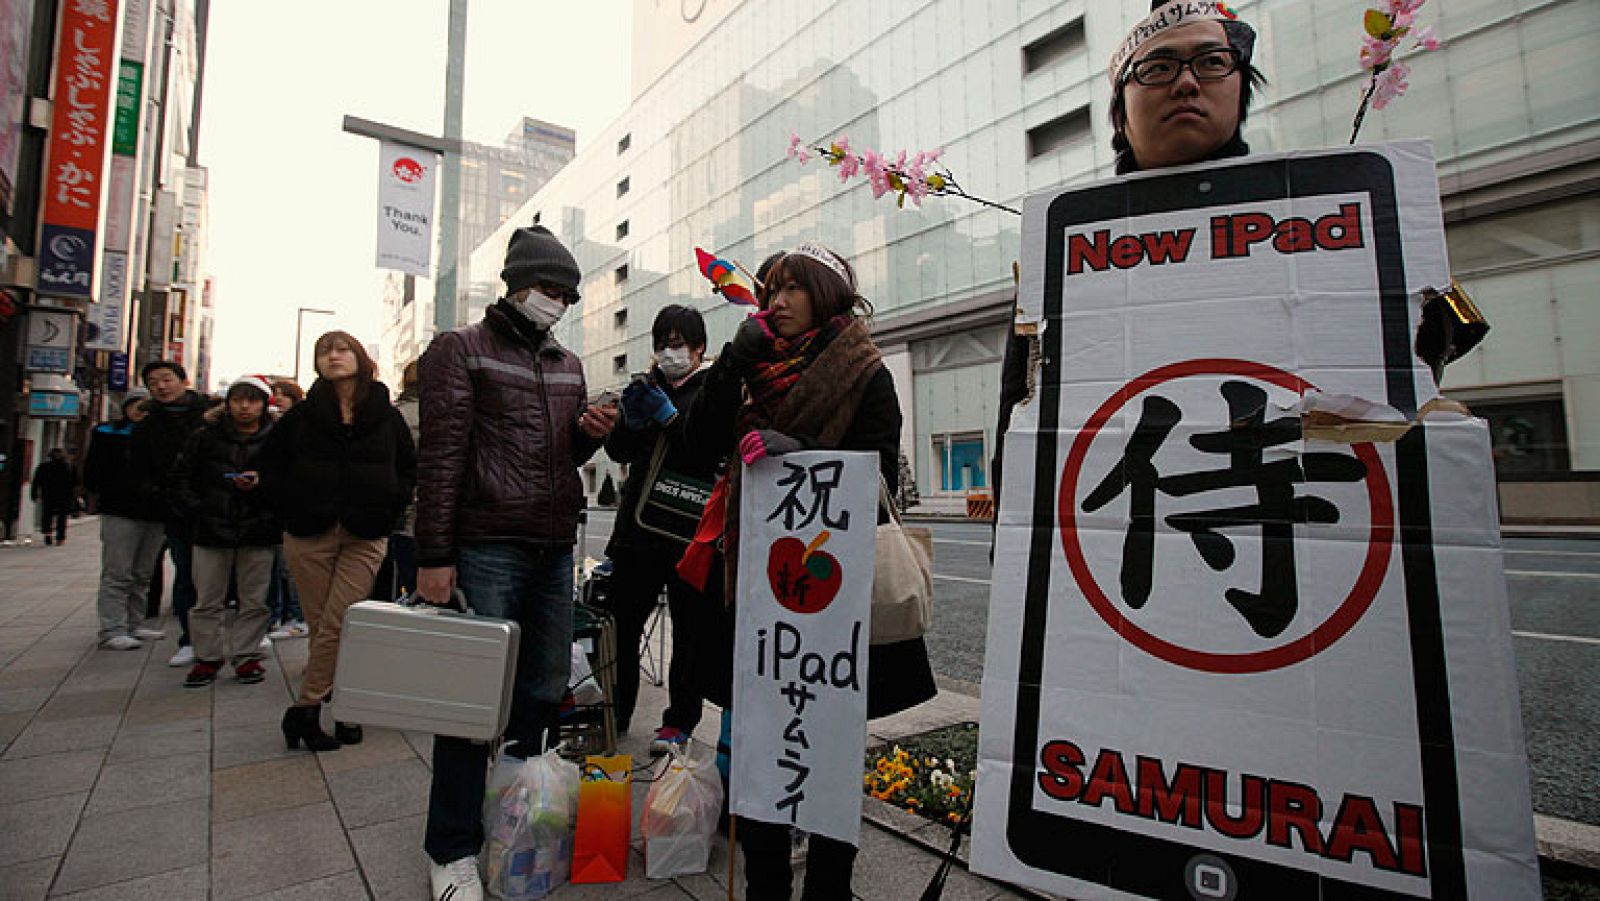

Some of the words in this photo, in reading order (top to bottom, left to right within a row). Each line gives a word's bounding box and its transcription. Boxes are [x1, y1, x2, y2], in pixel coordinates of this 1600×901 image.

[383, 206, 428, 225] Thank
[391, 219, 422, 236] You.
[1067, 228, 1196, 275] New
[1210, 202, 1365, 260] iPad
[766, 460, 850, 530] 祝
[1081, 380, 1368, 638] 侍
[757, 621, 862, 691] iPad
[775, 681, 817, 824] サムライ
[1037, 740, 1428, 878] SAMURAI
